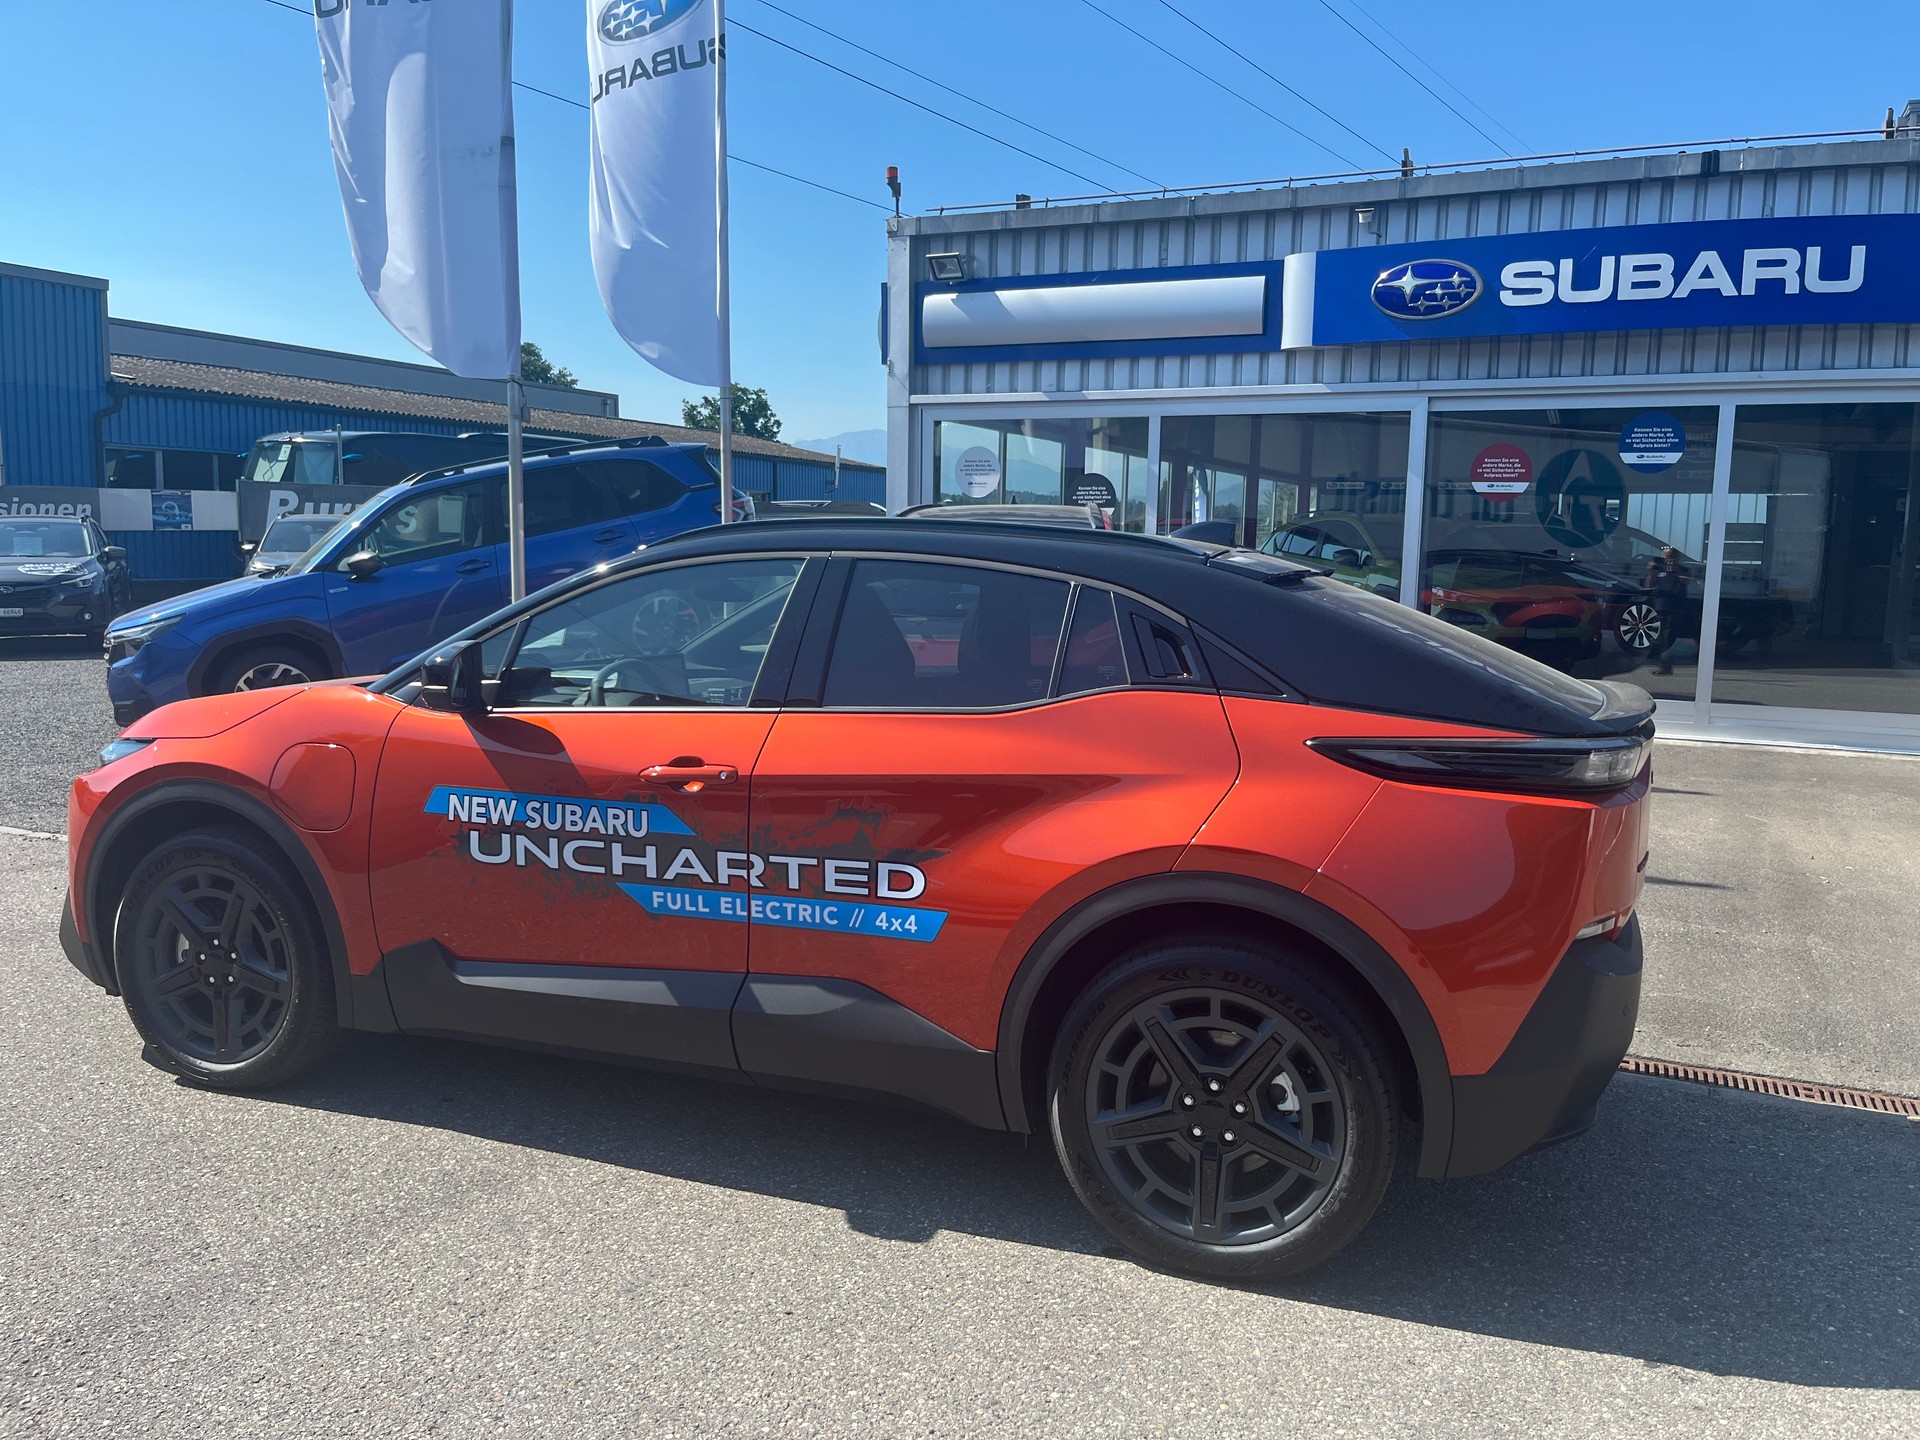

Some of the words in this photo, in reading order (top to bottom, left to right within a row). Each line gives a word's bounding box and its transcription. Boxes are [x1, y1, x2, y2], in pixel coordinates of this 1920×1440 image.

[1500, 246, 1866, 306] SUBARU
[449, 795, 517, 825] NEW
[526, 802, 647, 837] SUBARU
[470, 830, 925, 899] UNCHARTED
[653, 892, 709, 912] FULL
[721, 898, 838, 925] ELECTRIC
[875, 911, 918, 933] 4x4
[1221, 970, 1333, 1038] DUNLOP
